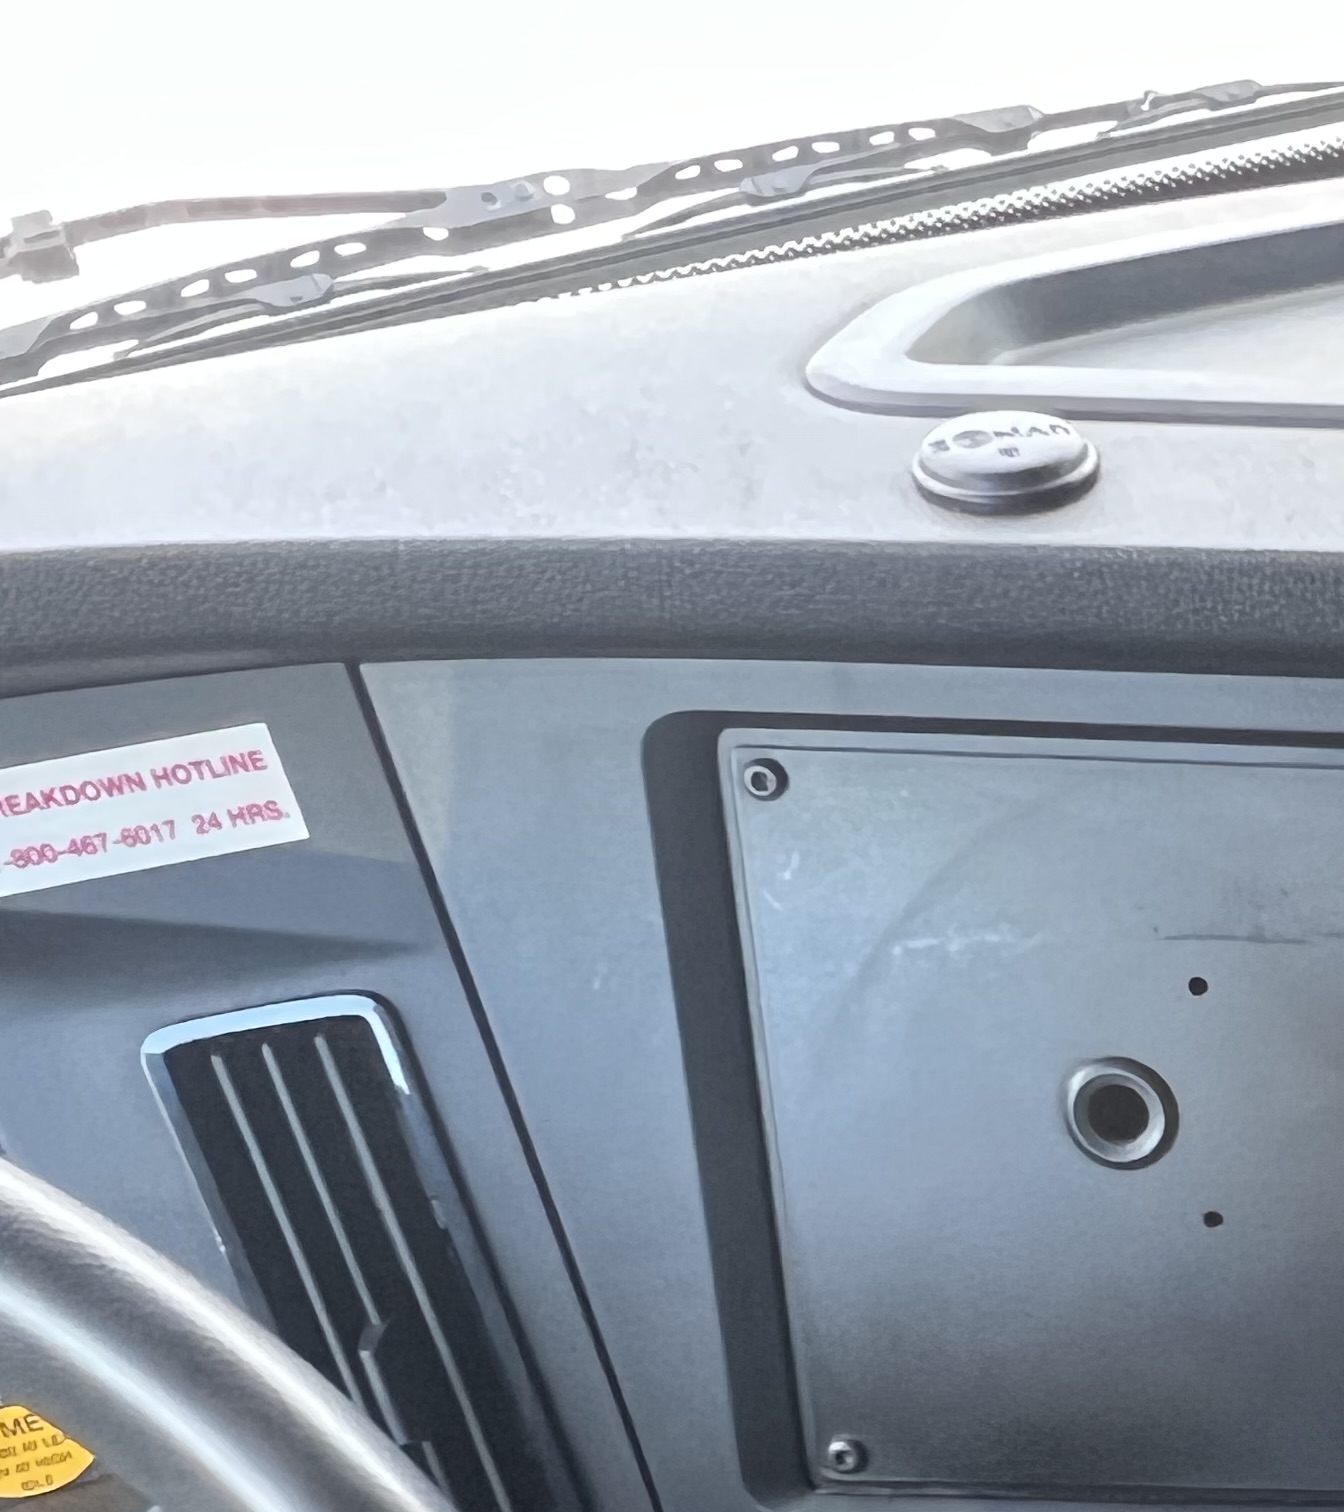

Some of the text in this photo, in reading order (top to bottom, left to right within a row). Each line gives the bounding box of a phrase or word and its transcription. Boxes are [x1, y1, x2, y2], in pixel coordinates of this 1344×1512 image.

[150, 750, 268, 789] HOTLINE
[191, 811, 223, 836] 24
[226, 800, 291, 829] HRS.
